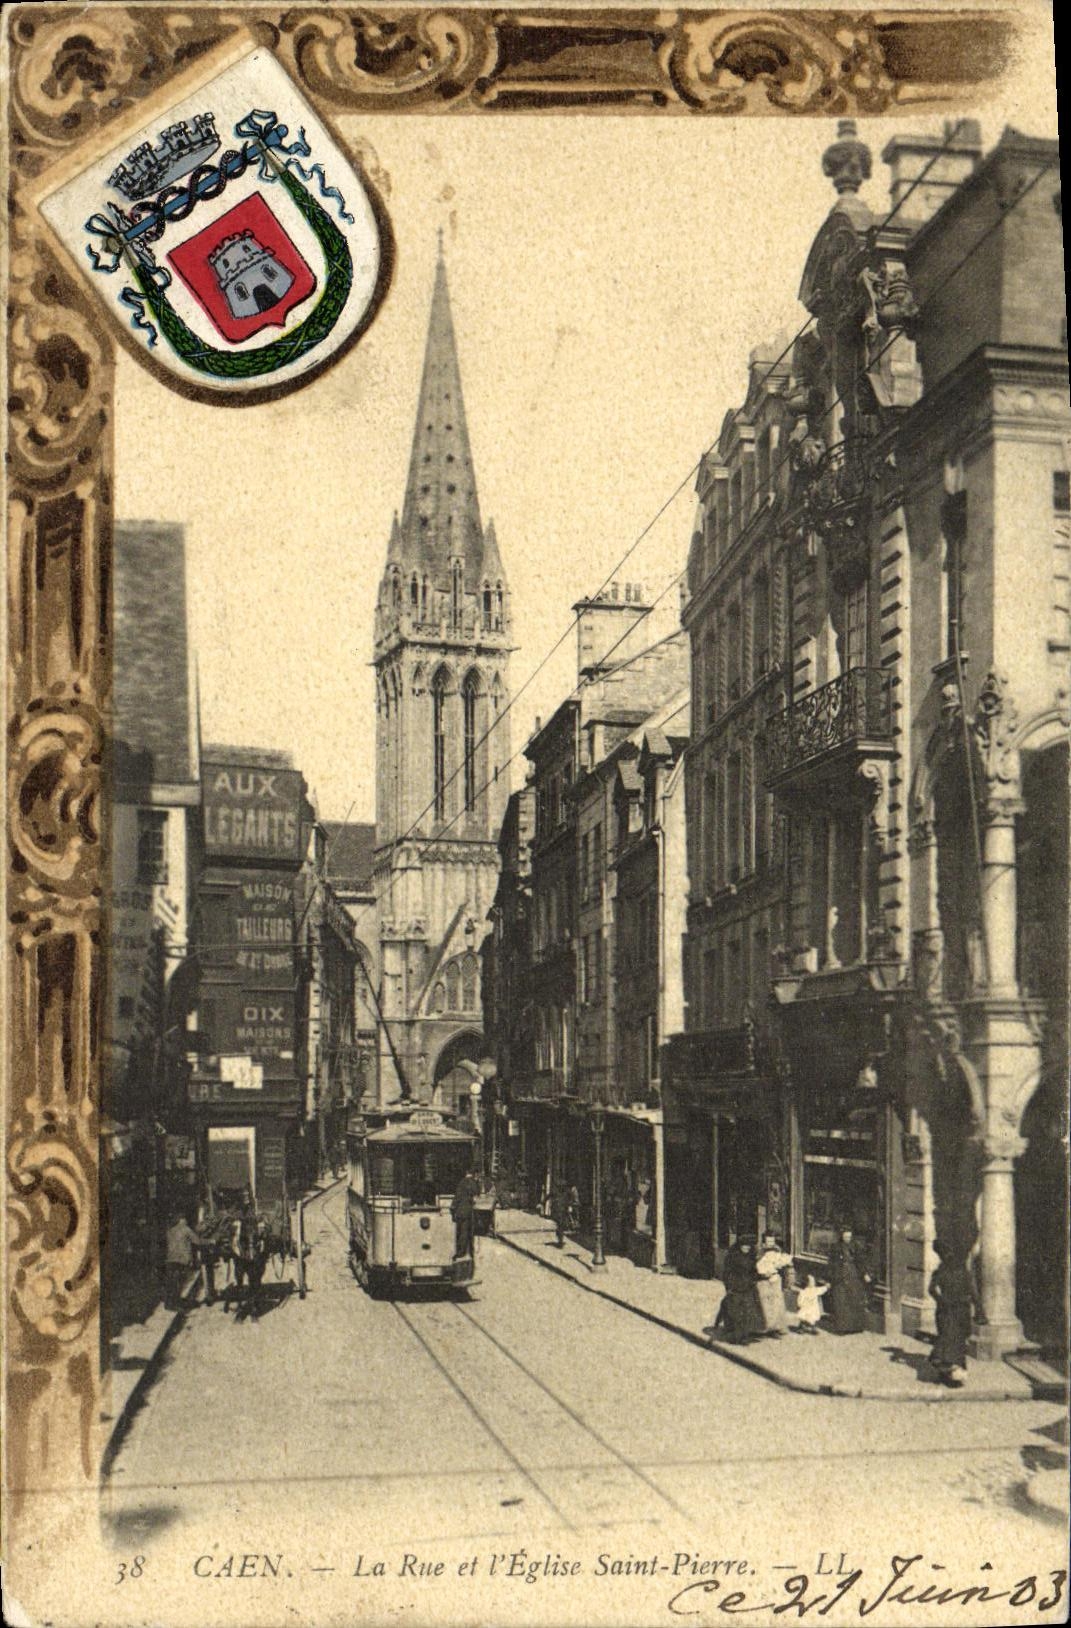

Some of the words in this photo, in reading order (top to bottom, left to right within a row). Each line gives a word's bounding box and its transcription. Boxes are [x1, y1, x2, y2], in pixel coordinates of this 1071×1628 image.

[213, 771, 279, 797] AUX
[242, 883, 293, 903] MAISON
[244, 1007, 284, 1021] DIX
[236, 1027, 291, 1039] MAISONS
